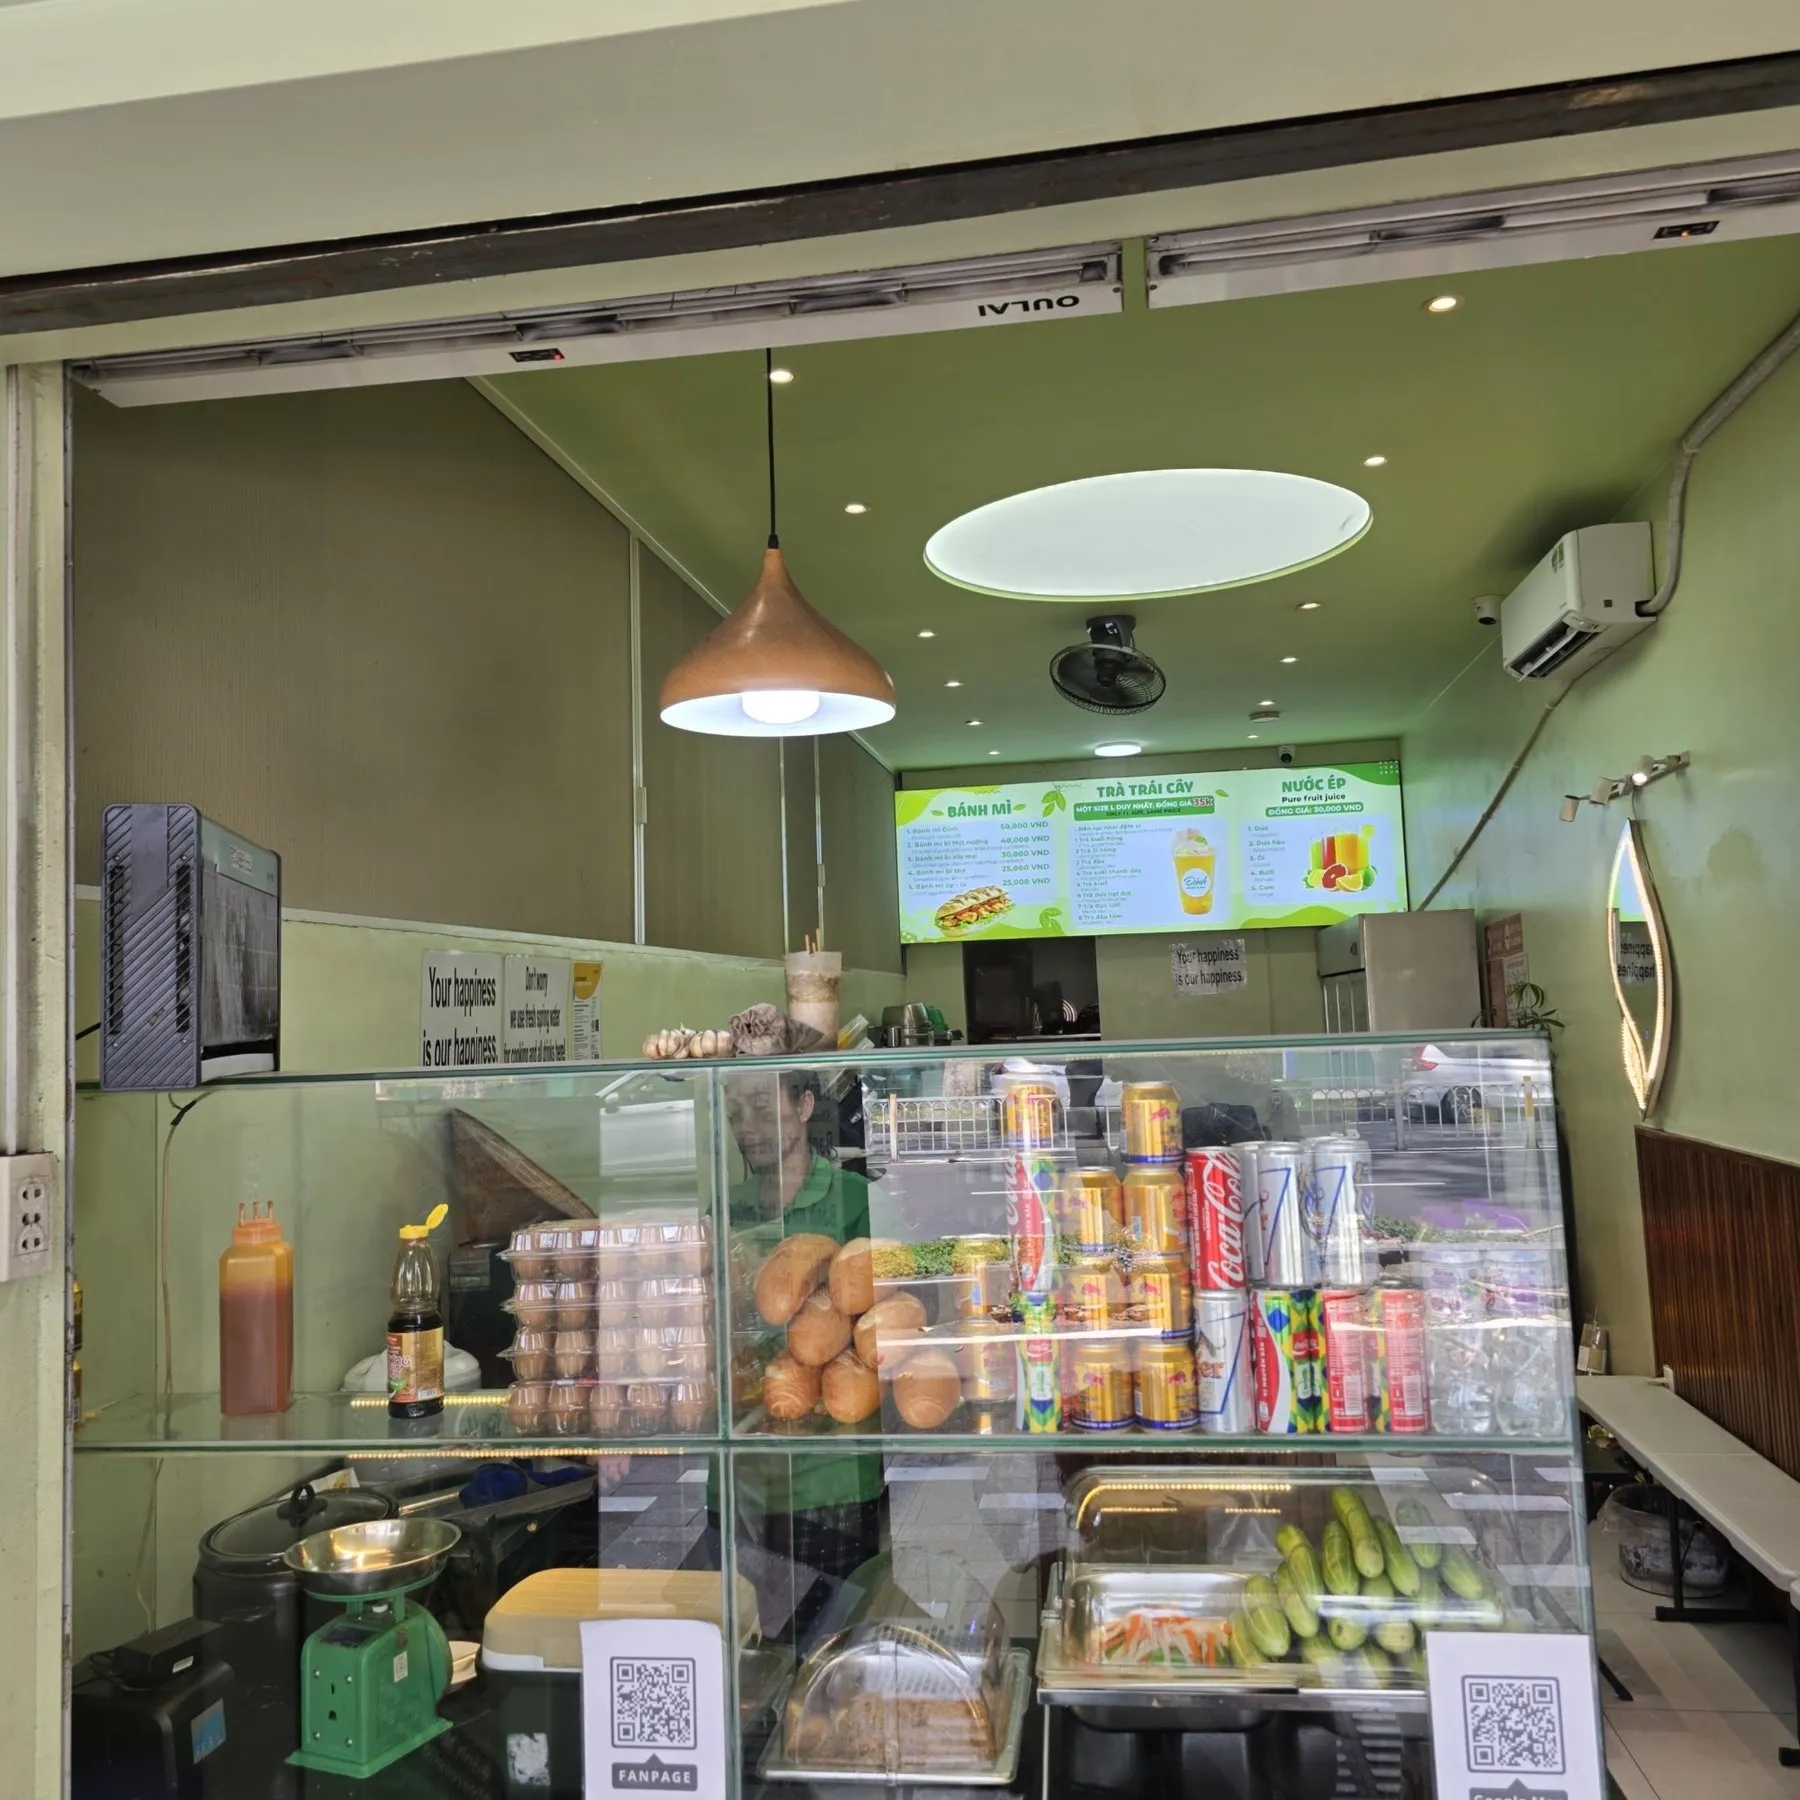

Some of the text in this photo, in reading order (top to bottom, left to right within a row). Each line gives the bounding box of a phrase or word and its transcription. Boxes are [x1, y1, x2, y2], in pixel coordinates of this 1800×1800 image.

[1097, 779, 1194, 797] TRÀ TRÁI CÂY
[1281, 774, 1346, 792] NƯỚC ÉP
[1304, 794, 1323, 802] fruit
[1325, 793, 1346, 801] juice
[947, 800, 1012, 818] BÁNH MÌ
[1116, 803, 1132, 811] DUY
[1343, 804, 1362, 812] VND
[1000, 822, 1028, 830] 50,000
[1001, 850, 1029, 858] 30,000
[1176, 947, 1240, 966] Your happiness
[525, 966, 536, 991] Don't
[429, 966, 496, 1017] Your happiness
[525, 1003, 536, 1028] fresh
[422, 1026, 499, 1067] is our happiness.
[618, 1769, 691, 1784] FANPAGE
